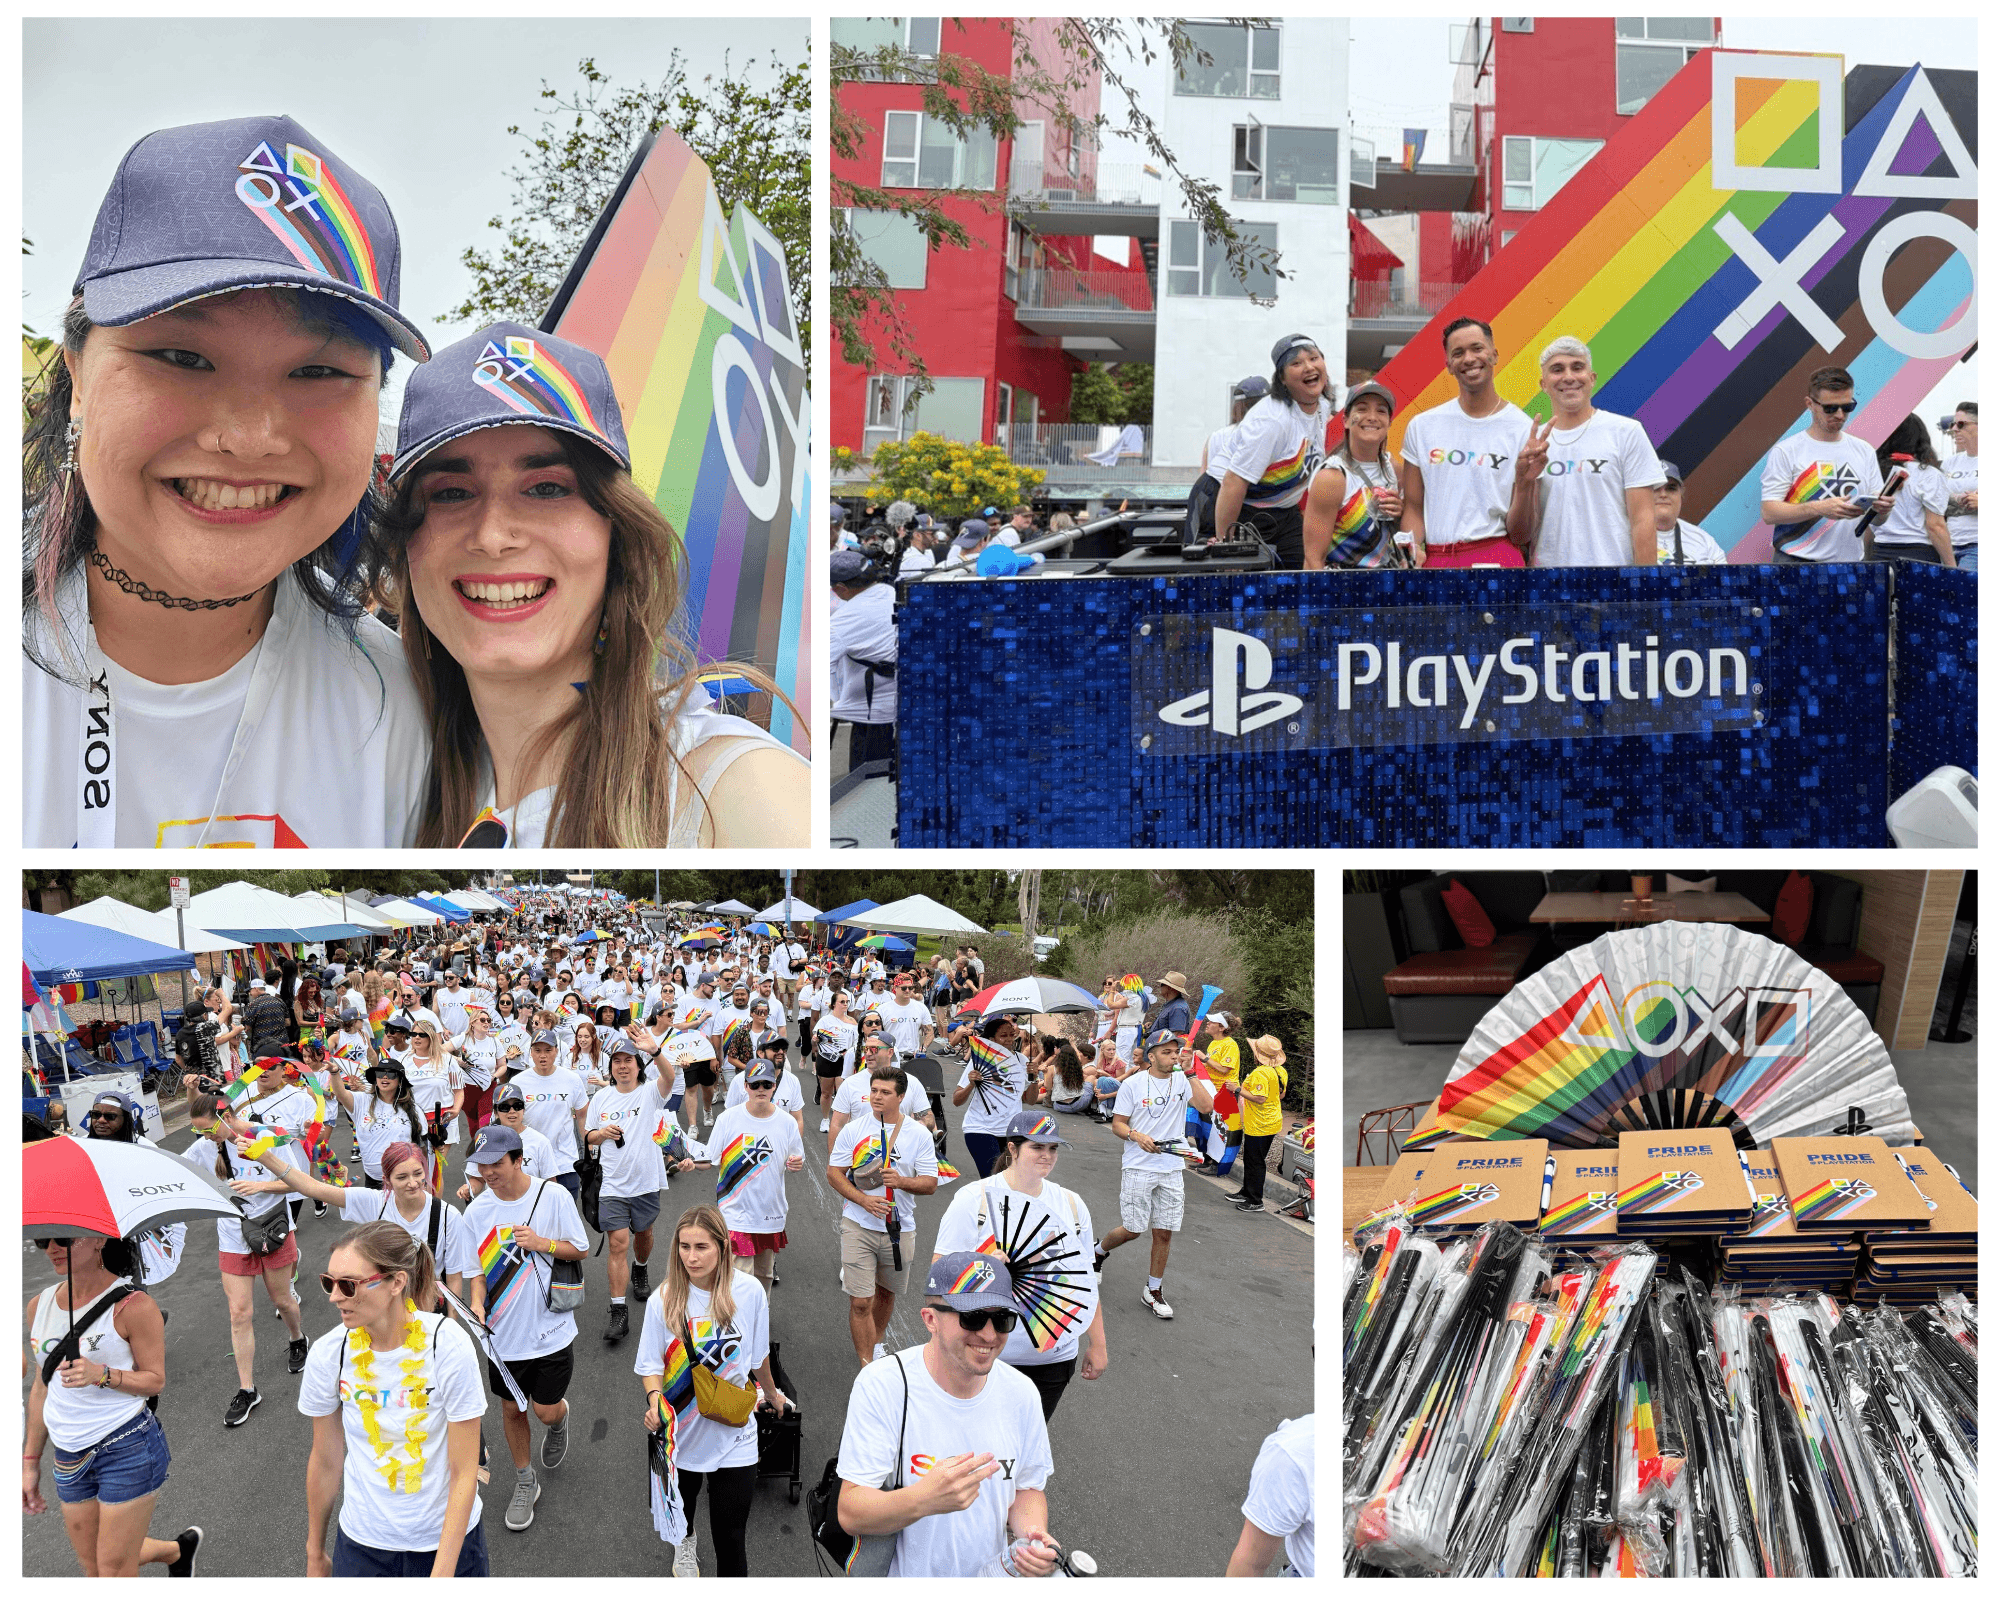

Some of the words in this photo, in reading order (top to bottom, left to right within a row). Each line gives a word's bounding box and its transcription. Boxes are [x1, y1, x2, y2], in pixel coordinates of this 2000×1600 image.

[1428, 447, 1509, 470] SONY
[1547, 458, 1609, 477] ONY
[668, 1039, 701, 1052] SONY
[525, 1093, 569, 1103] SONY
[600, 1106, 641, 1121] SONY
[1647, 1144, 1713, 1155] PRIDE
[1456, 1156, 1523, 1167] PRIDE
[1807, 1153, 1873, 1162] PRIDE
[128, 1182, 186, 1198] SONY
[910, 1453, 1016, 1481] SY
